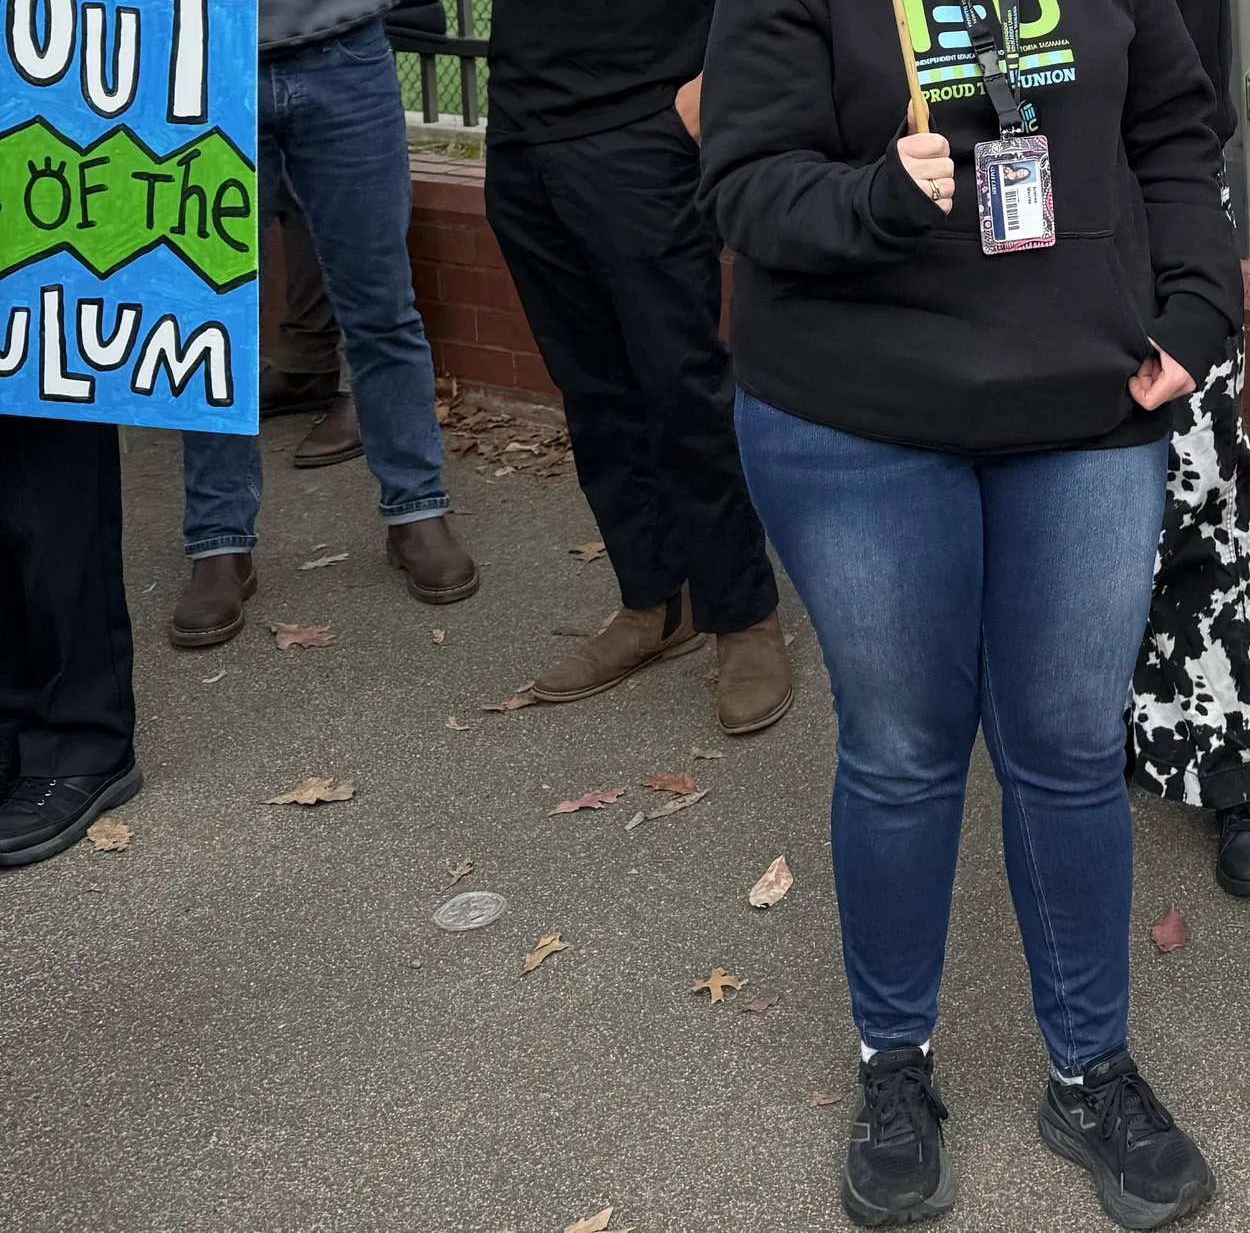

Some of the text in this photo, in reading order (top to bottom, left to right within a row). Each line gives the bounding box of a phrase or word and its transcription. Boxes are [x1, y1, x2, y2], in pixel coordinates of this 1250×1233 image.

[921, 83, 975, 103] PROUD
[1020, 68, 1076, 89] UNION
[23, 156, 109, 230] OF
